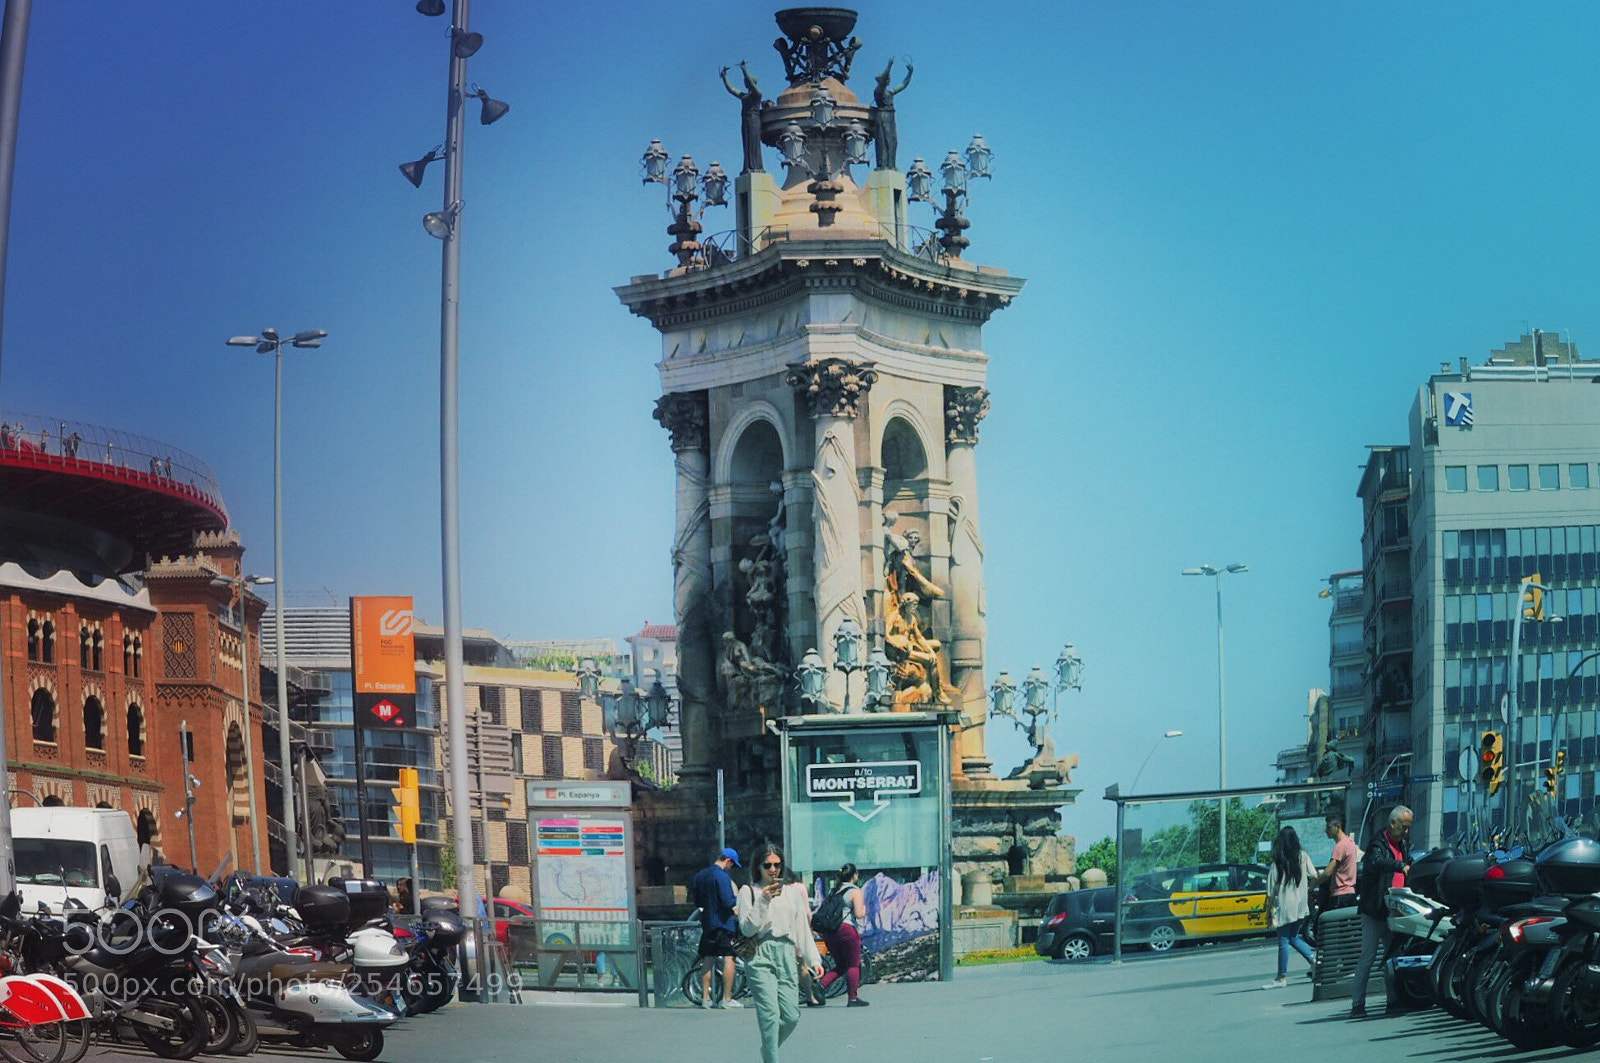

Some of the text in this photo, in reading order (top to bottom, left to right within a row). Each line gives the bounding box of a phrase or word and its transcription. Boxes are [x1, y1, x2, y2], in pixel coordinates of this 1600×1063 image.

[375, 682, 405, 691] Espanya
[379, 705, 392, 716] M
[854, 767, 872, 776] a/to
[813, 775, 915, 790] MONTSERRAT
[569, 791, 600, 799] Espanya
